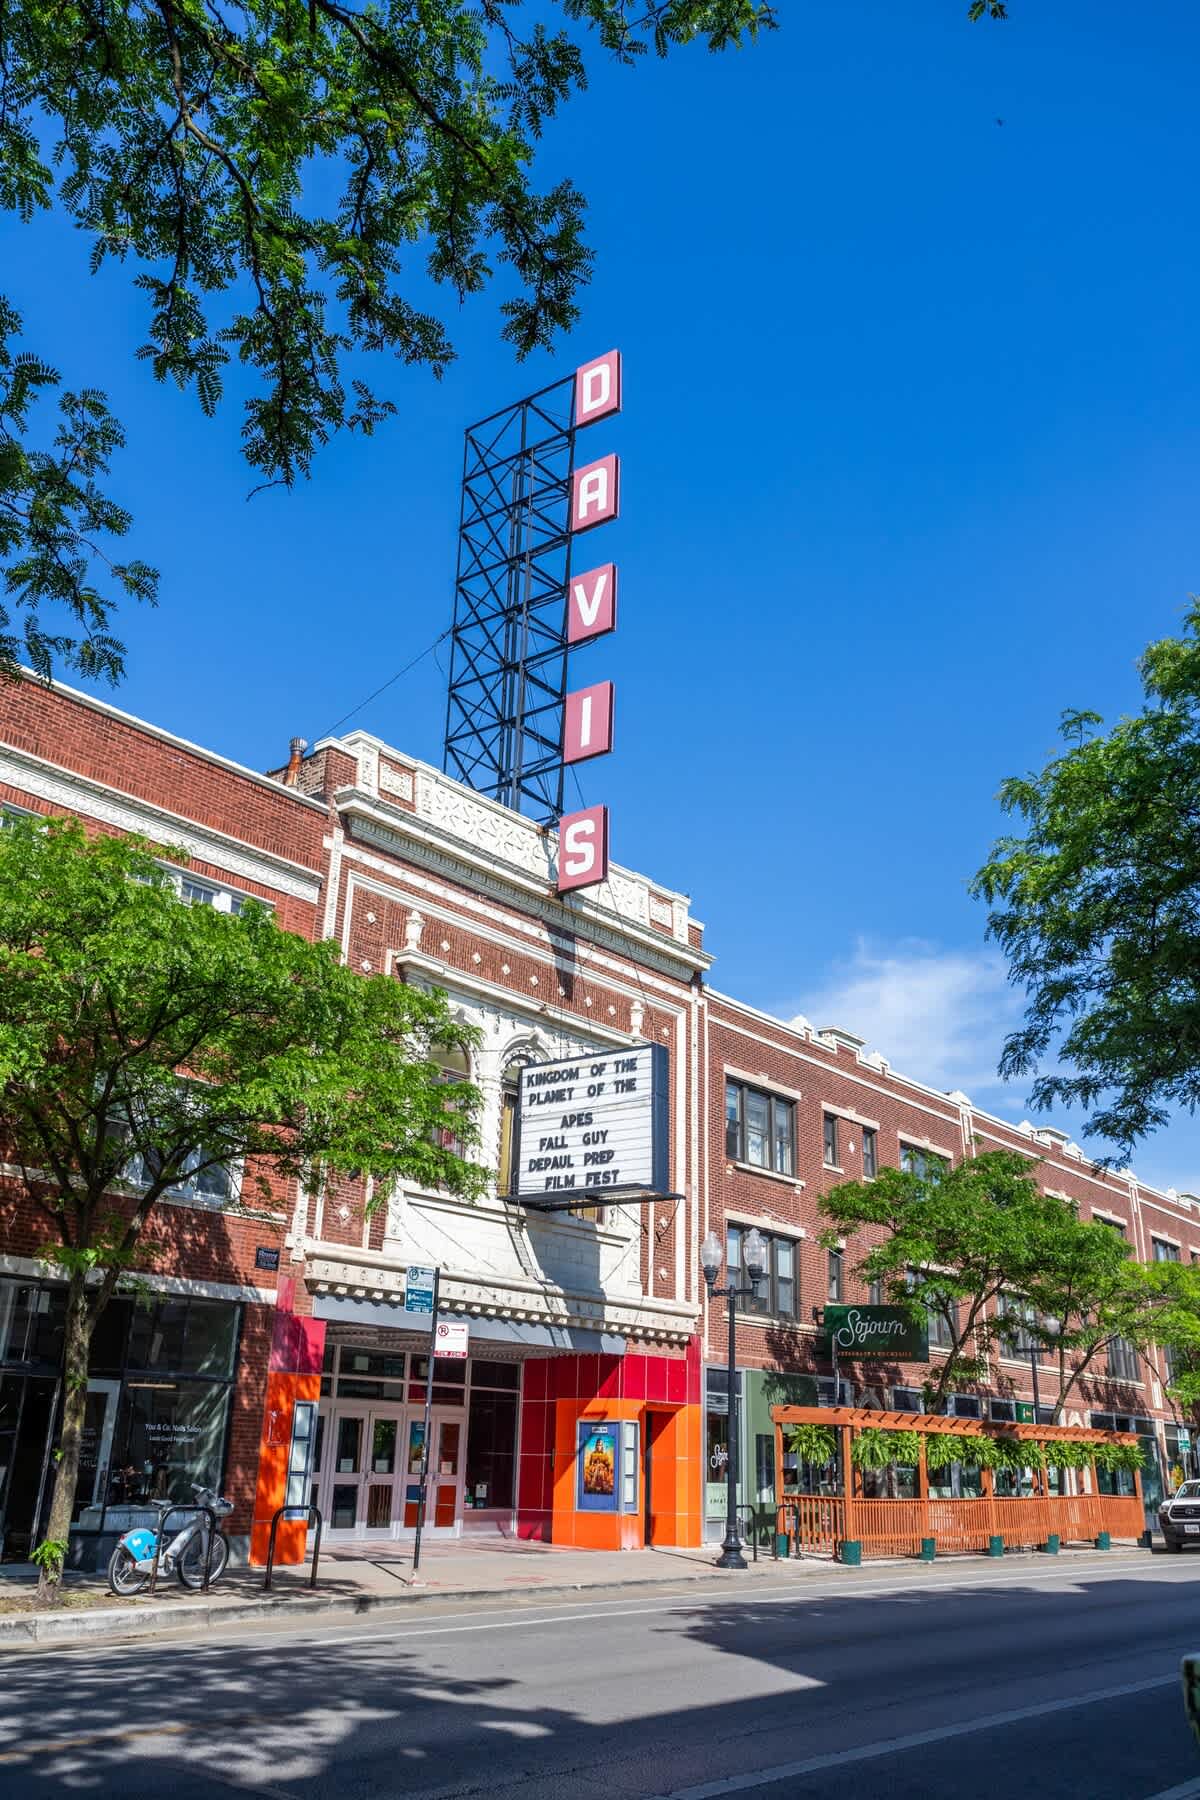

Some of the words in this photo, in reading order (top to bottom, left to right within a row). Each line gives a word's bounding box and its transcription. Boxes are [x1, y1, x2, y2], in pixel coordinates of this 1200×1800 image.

[564, 362, 611, 878] DAVIS
[527, 1067, 579, 1088] KINGDOM
[590, 1063, 607, 1077] OF
[614, 1058, 638, 1074] THE
[529, 1087, 575, 1107] PLANET
[587, 1083, 605, 1097] OF
[614, 1078, 637, 1094] THE
[560, 1112, 594, 1129] APES
[539, 1136, 569, 1152] FALL
[582, 1130, 609, 1146] GUY
[528, 1155, 574, 1173] DEPAUL
[584, 1150, 615, 1166] PREP
[545, 1174, 576, 1191] FILM
[585, 1169, 620, 1187] FEST
[837, 1309, 907, 1347] Sojourn
[145, 1423, 156, 1431] You
